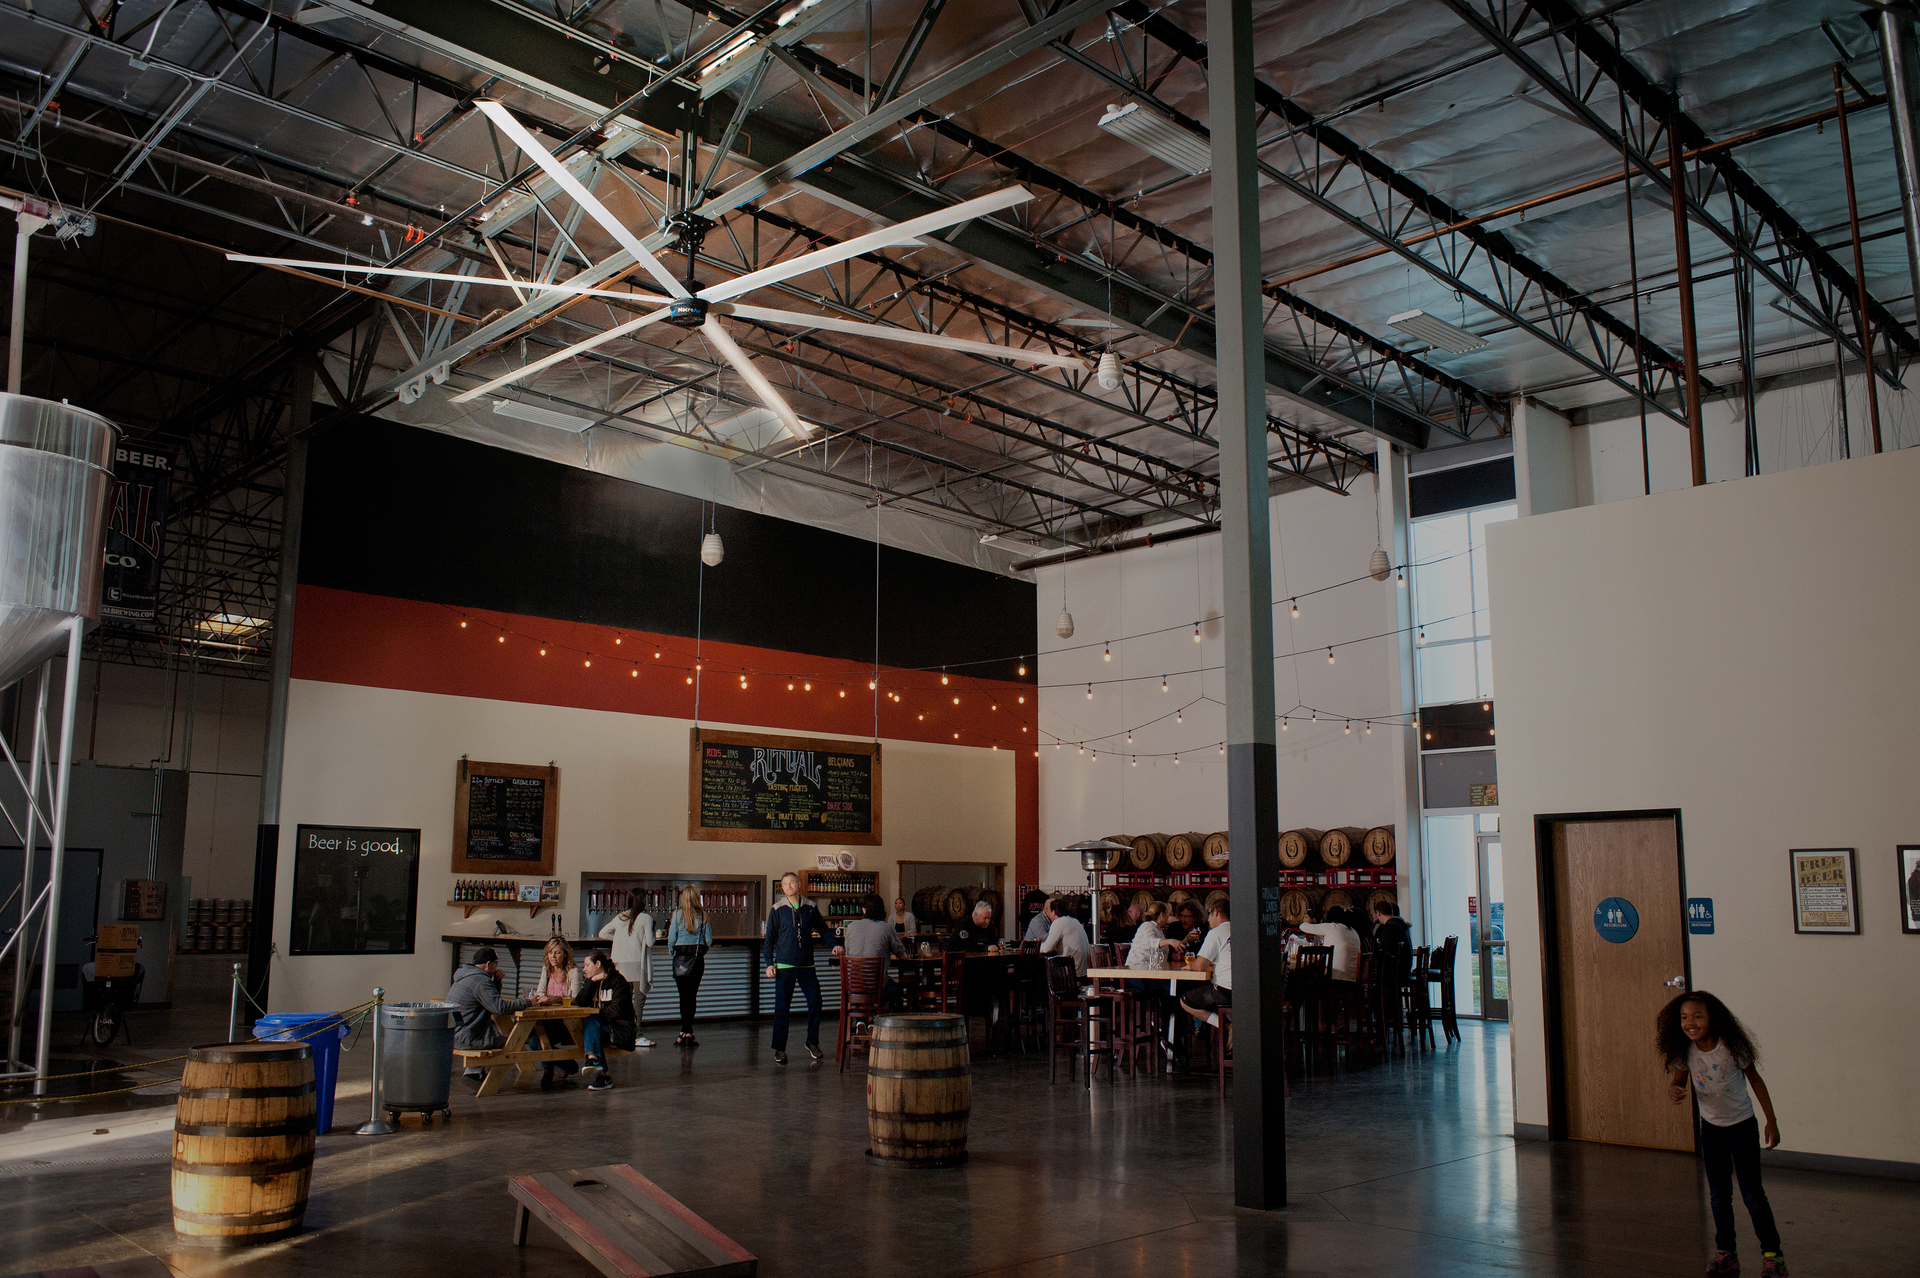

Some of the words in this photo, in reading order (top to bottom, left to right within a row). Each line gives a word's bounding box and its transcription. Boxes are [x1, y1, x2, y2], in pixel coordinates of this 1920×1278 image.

[115, 448, 172, 471] BEER.
[105, 553, 141, 569] CO.
[101, 607, 155, 618] ALBREWING.COM
[706, 748, 722, 758] REDS
[750, 747, 823, 790] RITUAL
[827, 756, 855, 769] BELGIANS
[766, 783, 788, 793] TASTING
[789, 784, 808, 793] FLIGHTS
[827, 801, 842, 811] DARK
[841, 801, 854, 811] SIDE
[766, 812, 776, 820] ALL
[778, 812, 794, 821] DRAFT
[308, 833, 342, 850] Beer
[345, 837, 357, 851] is
[360, 836, 404, 857] good.
[1800, 856, 1842, 872] FREE
[1801, 869, 1844, 884] BEER
